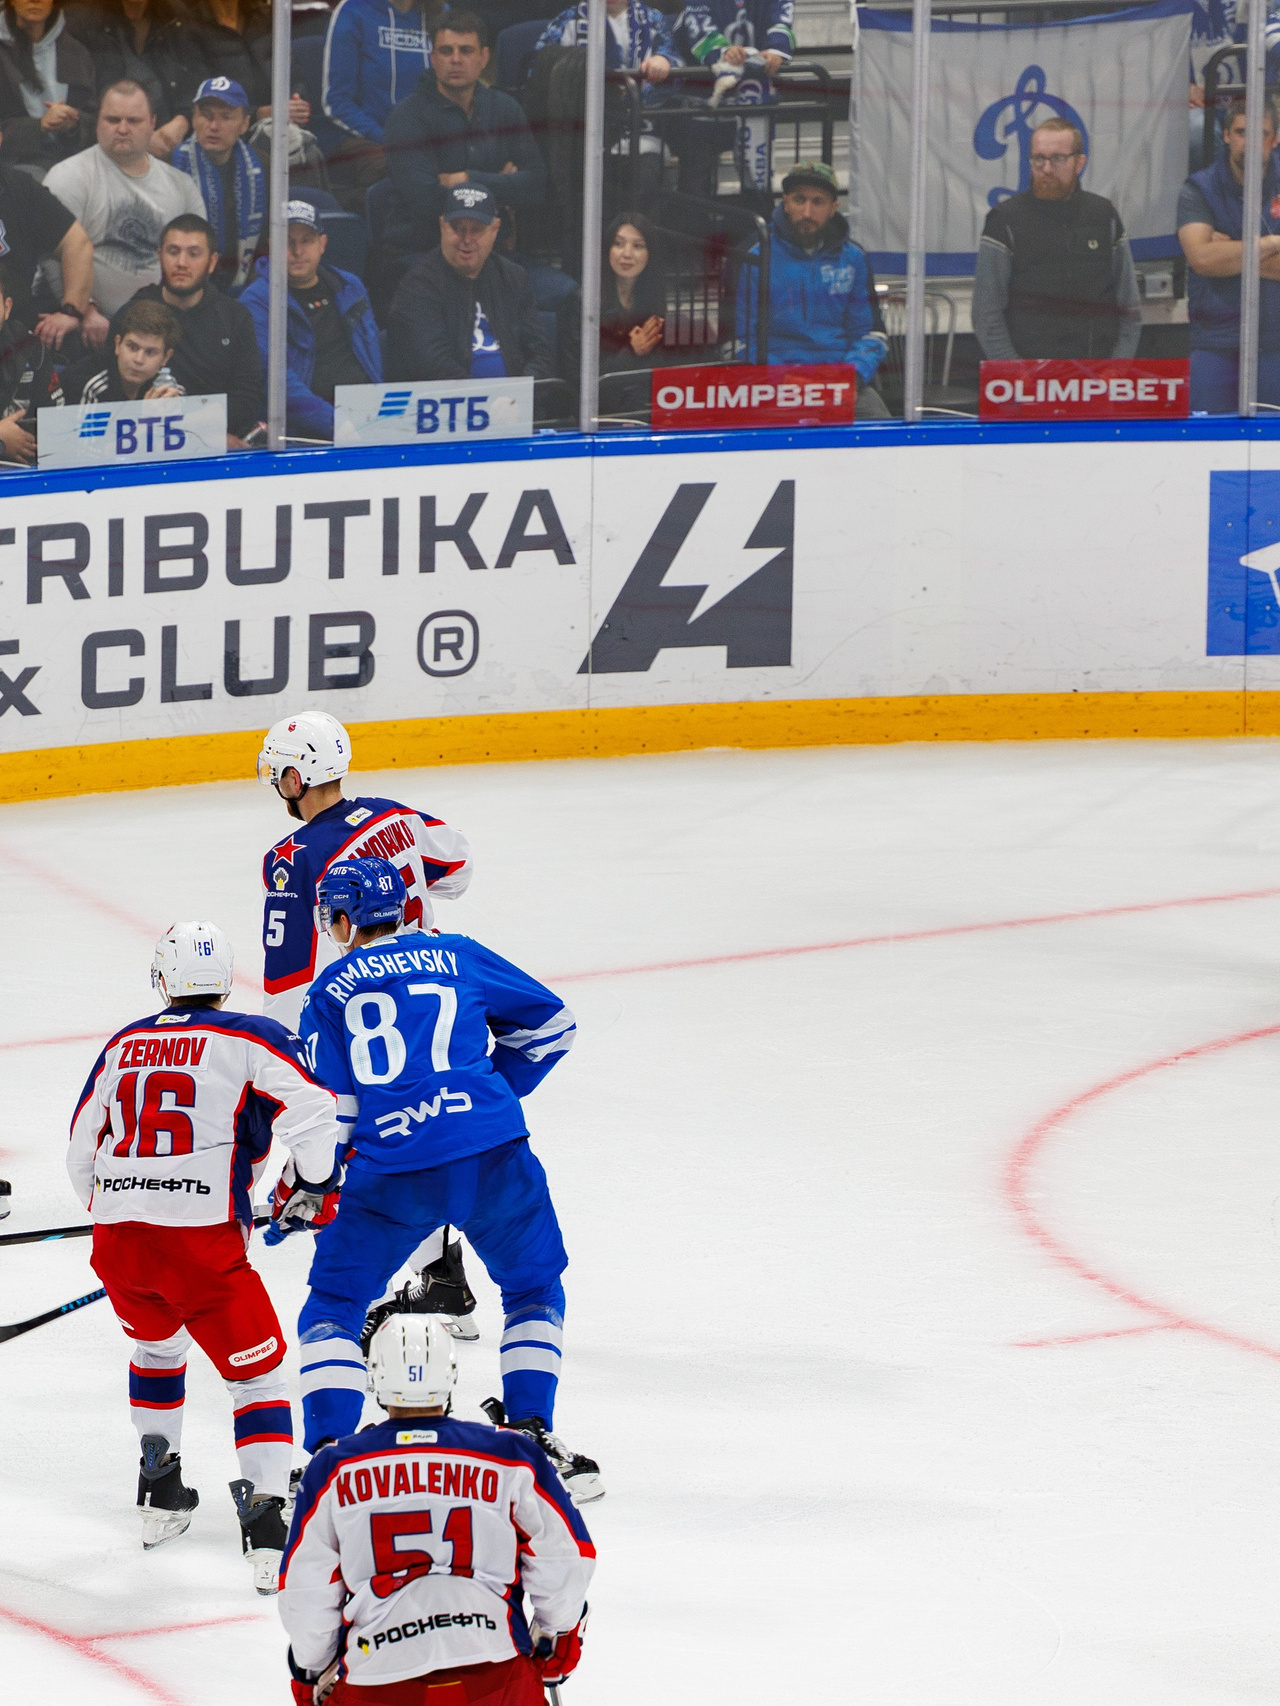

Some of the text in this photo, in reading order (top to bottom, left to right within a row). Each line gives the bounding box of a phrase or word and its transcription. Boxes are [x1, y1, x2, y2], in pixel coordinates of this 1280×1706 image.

[656, 382, 851, 411] OLIMPBET
[984, 377, 1185, 404] OLIMPBET
[417, 395, 490, 434] ВТБ
[115, 414, 187, 456] ВТБ
[80, 609, 377, 711] CLUB
[335, 739, 344, 754] 5
[379, 875, 394, 891] 87
[266, 910, 287, 947] 5
[325, 949, 459, 1005] RIMASHEVSKY
[344, 982, 458, 1086] 87
[118, 1037, 208, 1070] ZERNOV
[112, 1070, 197, 1158] 16
[102, 1176, 211, 1196] РОСНЕФТЬ
[233, 1341, 275, 1363] OLIMPBET
[408, 1365, 423, 1382] 51
[336, 1461, 499, 1508] KOVALENKO
[370, 1505, 475, 1599] 51
[372, 1612, 497, 1651] РОСНЕФТЬ
